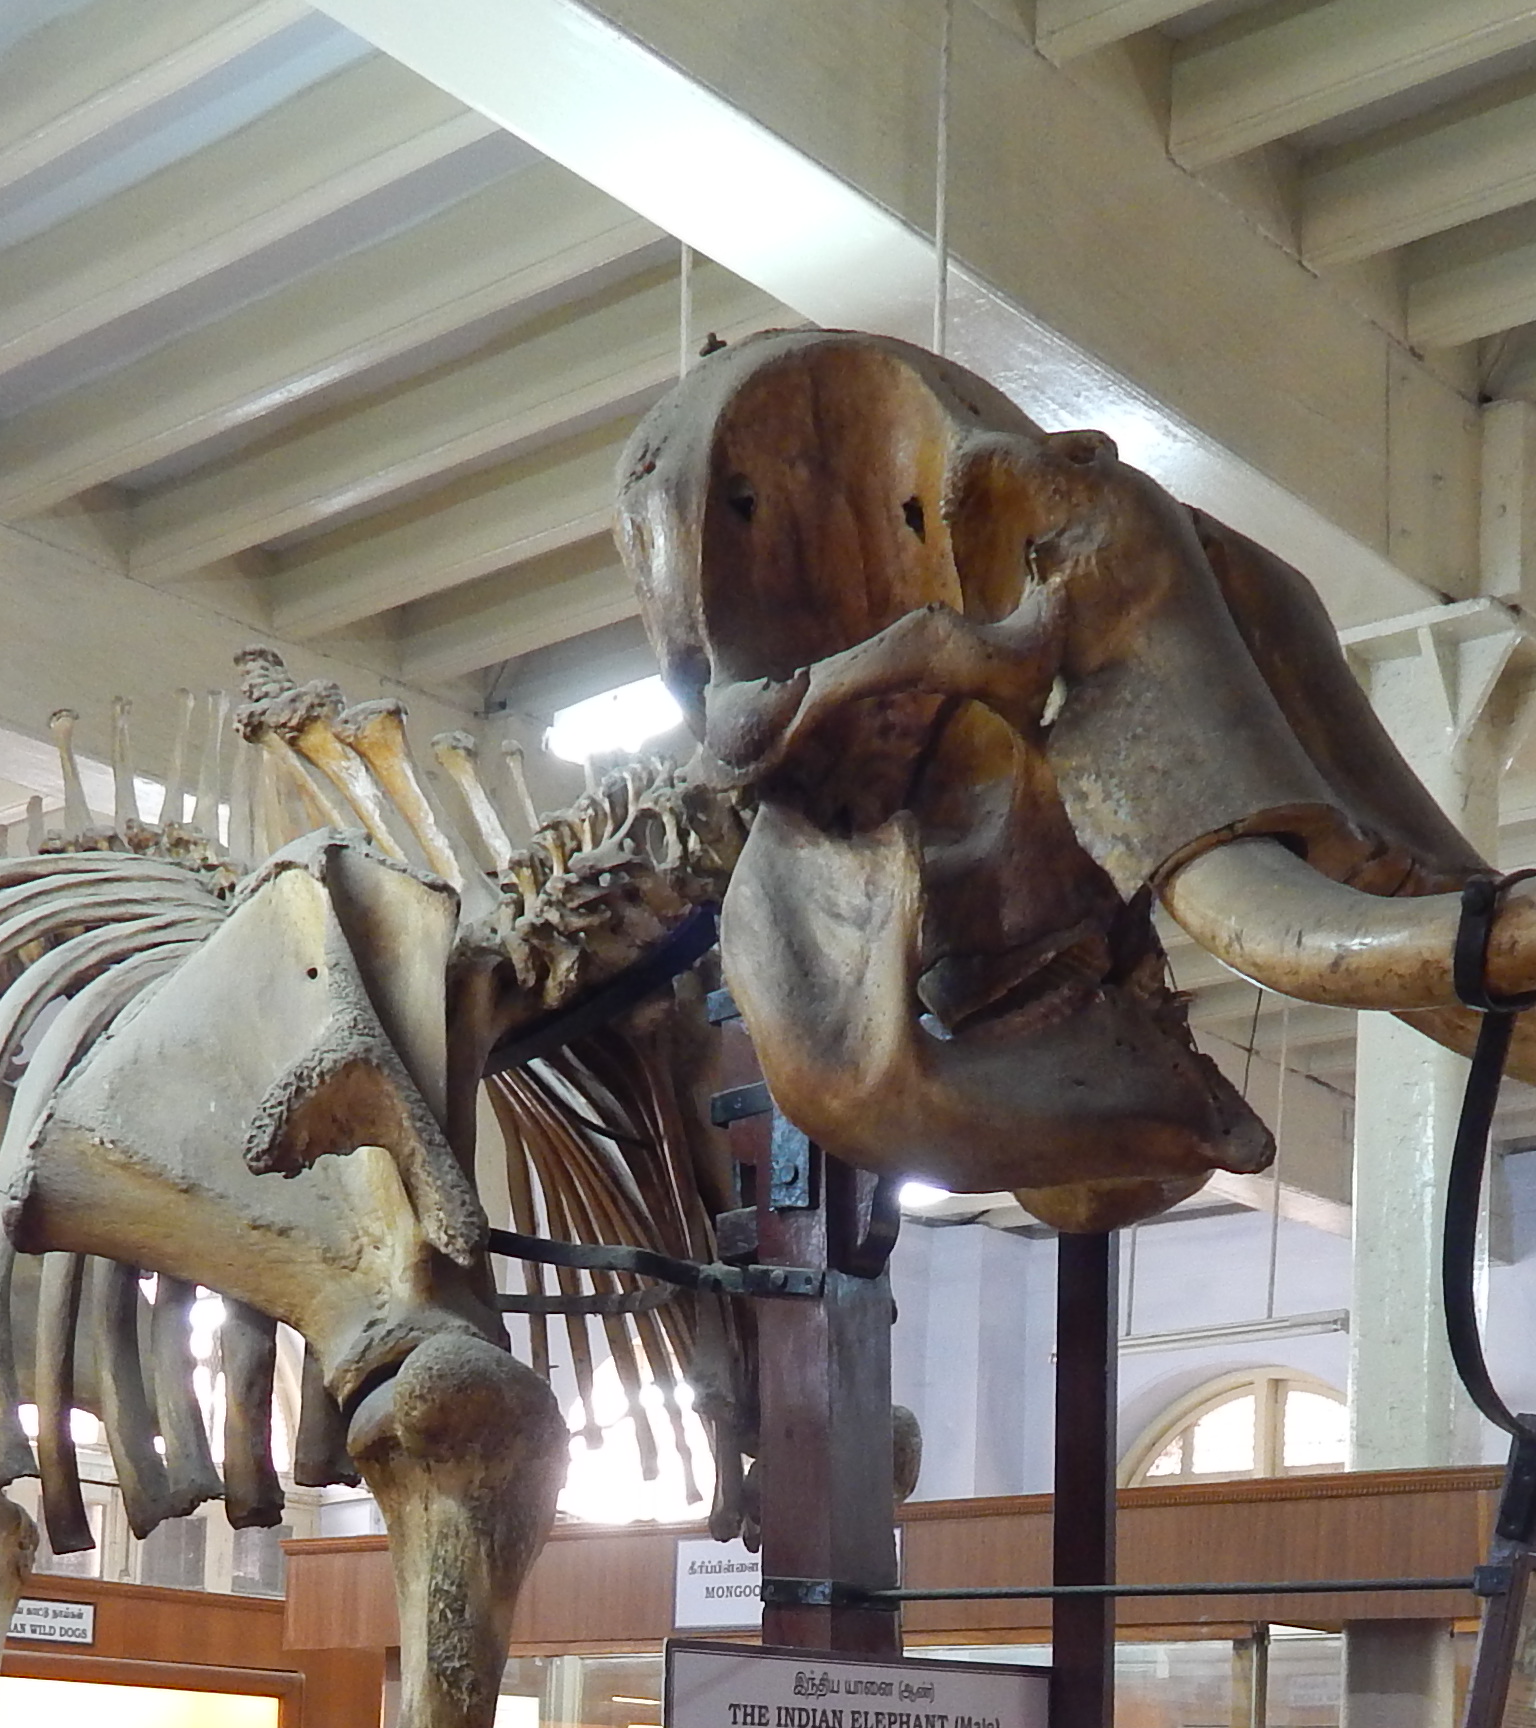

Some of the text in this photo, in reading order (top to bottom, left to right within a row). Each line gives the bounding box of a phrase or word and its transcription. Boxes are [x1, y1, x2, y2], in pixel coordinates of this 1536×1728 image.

[704, 1583, 761, 1600] MONGOO
[29, 1623, 56, 1637] WILD
[59, 1626, 88, 1639] DOGS
[793, 1670, 841, 1700] இந்திய
[845, 1679, 894, 1697] யானை
[728, 1703, 770, 1727] THE
